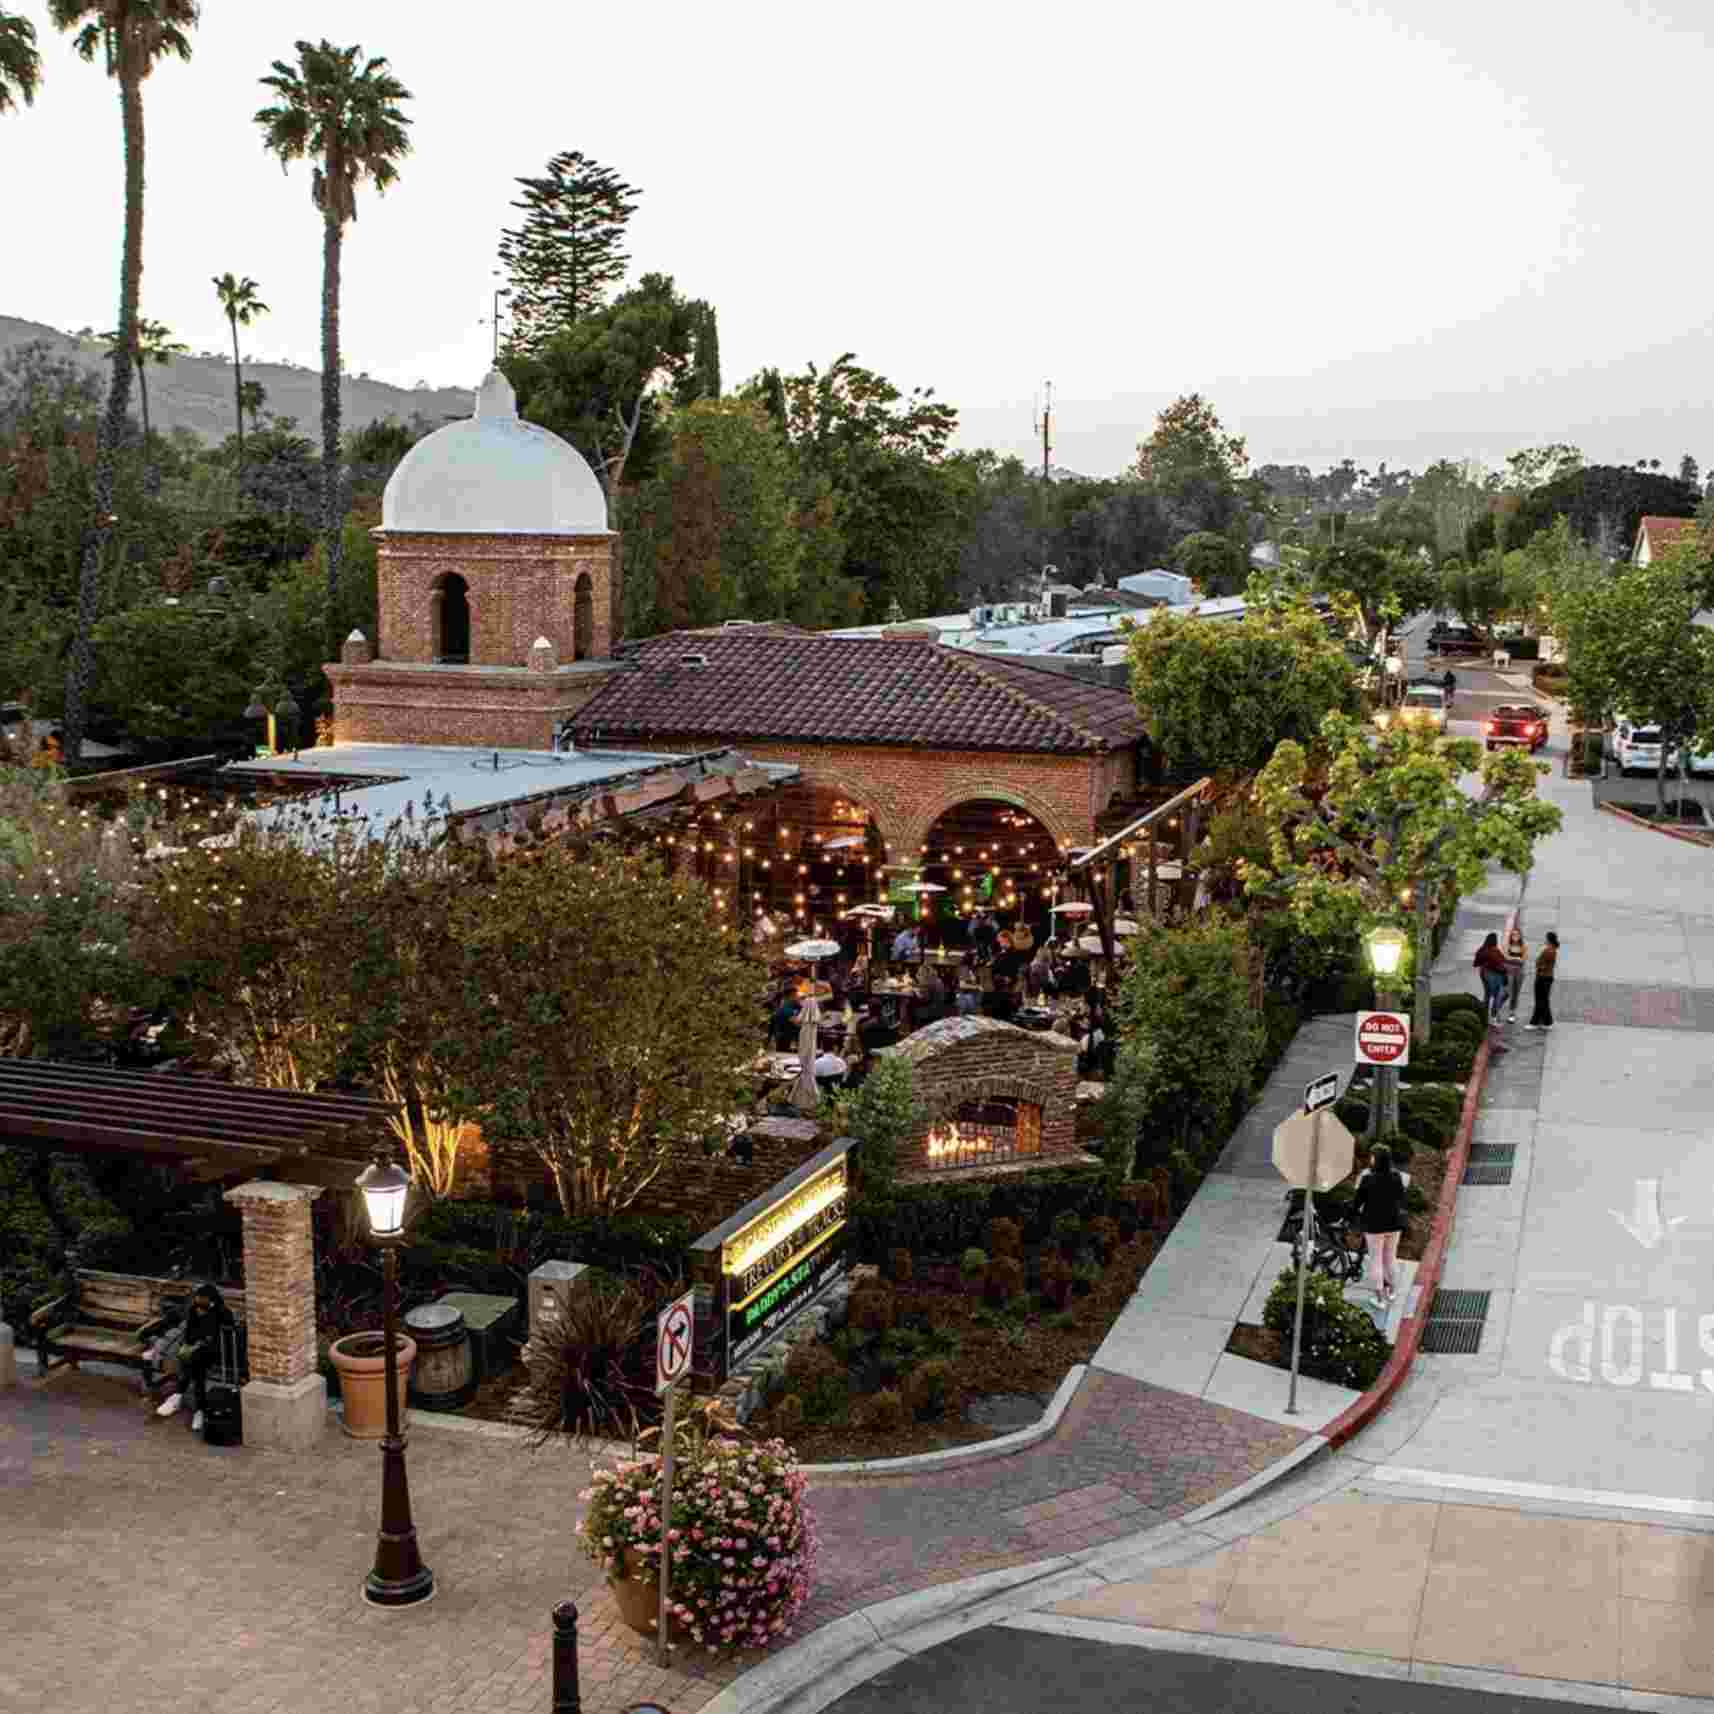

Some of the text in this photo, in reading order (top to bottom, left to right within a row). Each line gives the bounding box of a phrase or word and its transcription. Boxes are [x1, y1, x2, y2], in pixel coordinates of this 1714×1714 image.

[1365, 1022, 1400, 1032] DO NOT
[1367, 1044, 1397, 1056] ENTER
